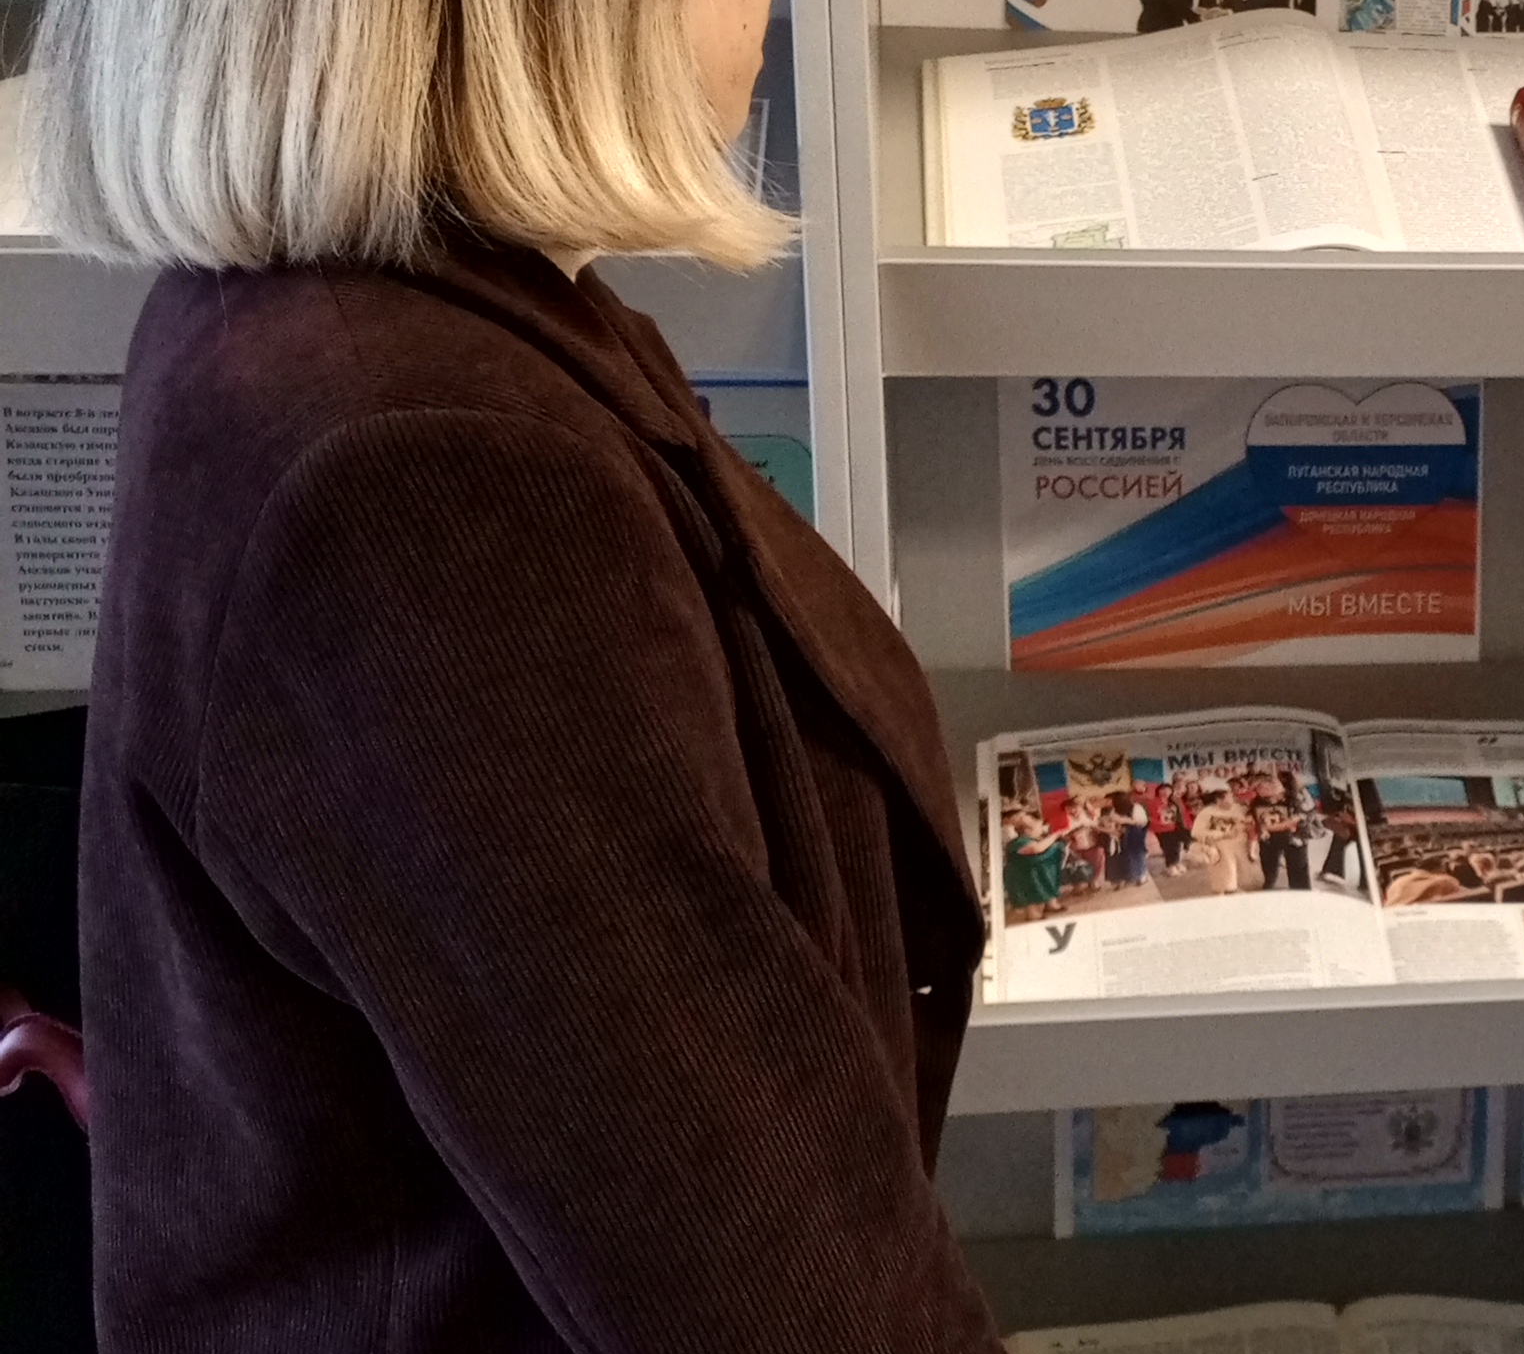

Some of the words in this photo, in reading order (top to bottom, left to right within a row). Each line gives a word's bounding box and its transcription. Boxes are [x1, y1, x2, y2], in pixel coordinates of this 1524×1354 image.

[1032, 377, 1096, 418] 30
[1033, 425, 1187, 451] СЕНТЯБРЯ
[1036, 468, 1184, 500] РОССИЕЙ
[1287, 464, 1360, 479] ЛУГАНСКАЯ
[1362, 463, 1429, 478] НАРОДНАЯ
[1316, 480, 1399, 494] РЕСПУБЛИКА
[1288, 594, 1332, 617] МЫ
[1341, 589, 1444, 617] ВМЕСТЕ
[1166, 750, 1214, 771] МЫ
[1046, 922, 1076, 956] У
